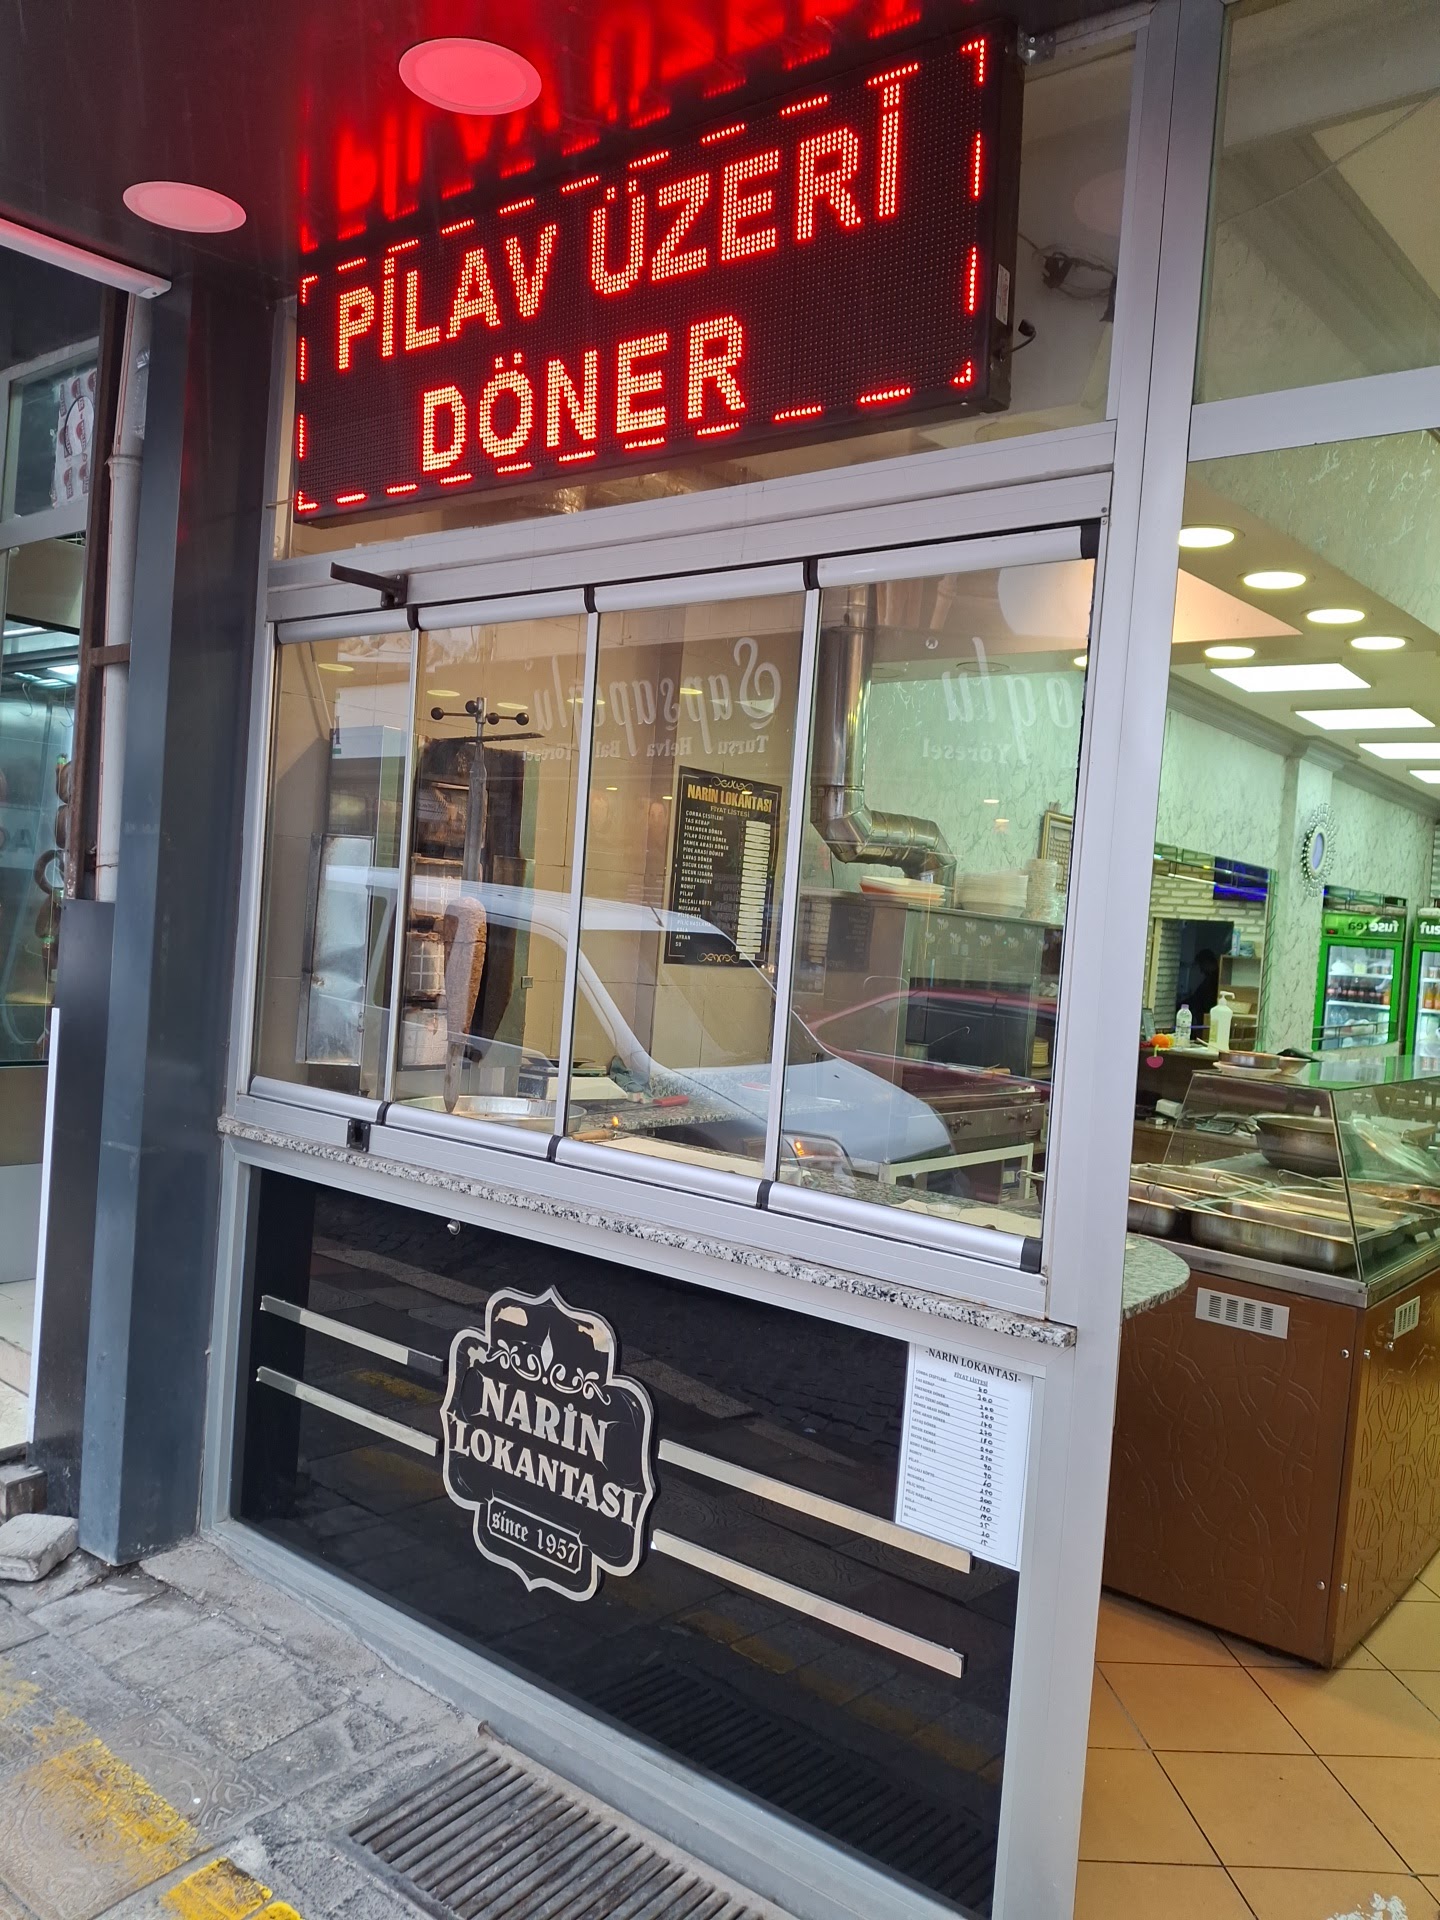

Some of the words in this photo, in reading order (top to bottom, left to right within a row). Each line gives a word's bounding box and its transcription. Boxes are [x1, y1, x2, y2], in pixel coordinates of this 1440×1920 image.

[336, 223, 558, 371] PİLAV
[420, 314, 746, 473] DÖNER
[687, 783, 719, 803] NARİN
[720, 790, 773, 813] LOKANTASI
[710, 805, 726, 814] FİYAT
[727, 807, 749, 817] LİSTESİ
[479, 1375, 609, 1464] NARİN
[453, 1417, 640, 1527] LOKANTASI
[491, 1511, 529, 1543] since
[537, 1528, 579, 1564] 1957
